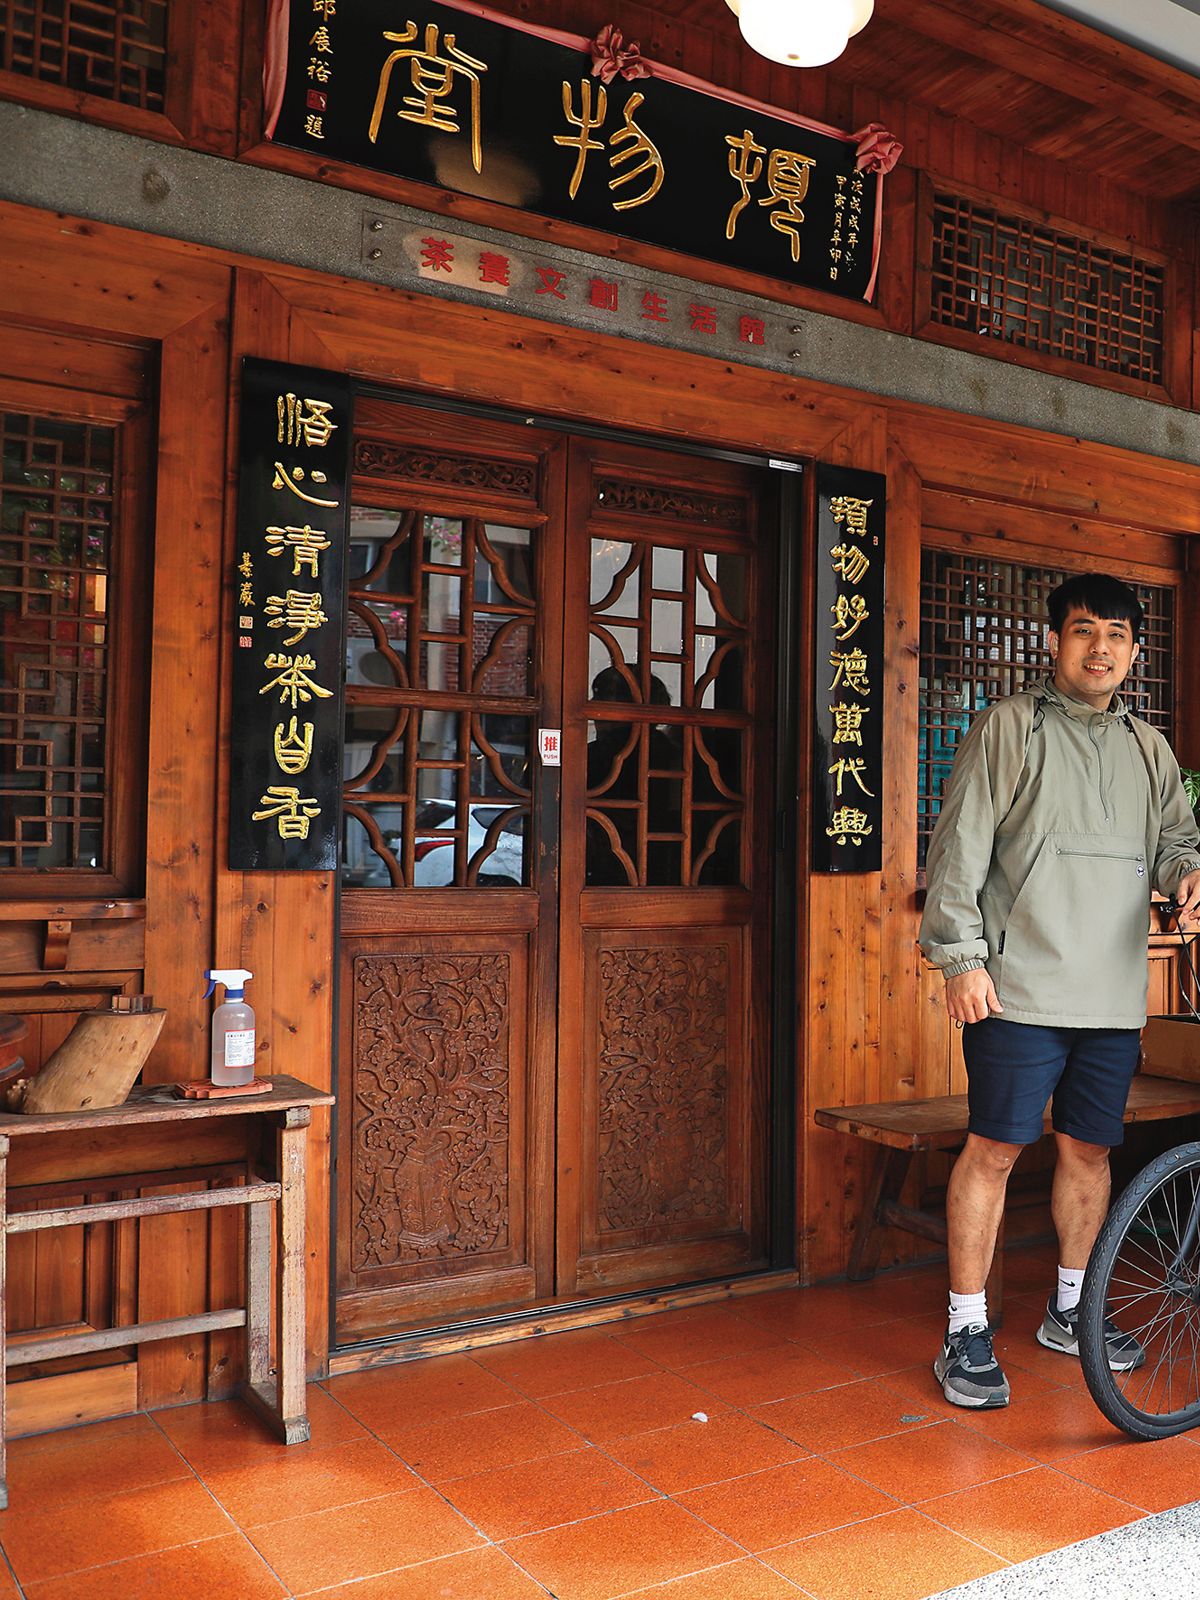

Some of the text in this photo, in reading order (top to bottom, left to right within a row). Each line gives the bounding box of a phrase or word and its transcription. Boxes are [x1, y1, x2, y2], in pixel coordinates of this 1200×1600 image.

[419, 236, 766, 346] 茶養文創生活館
[544, 736, 558, 752] 推
